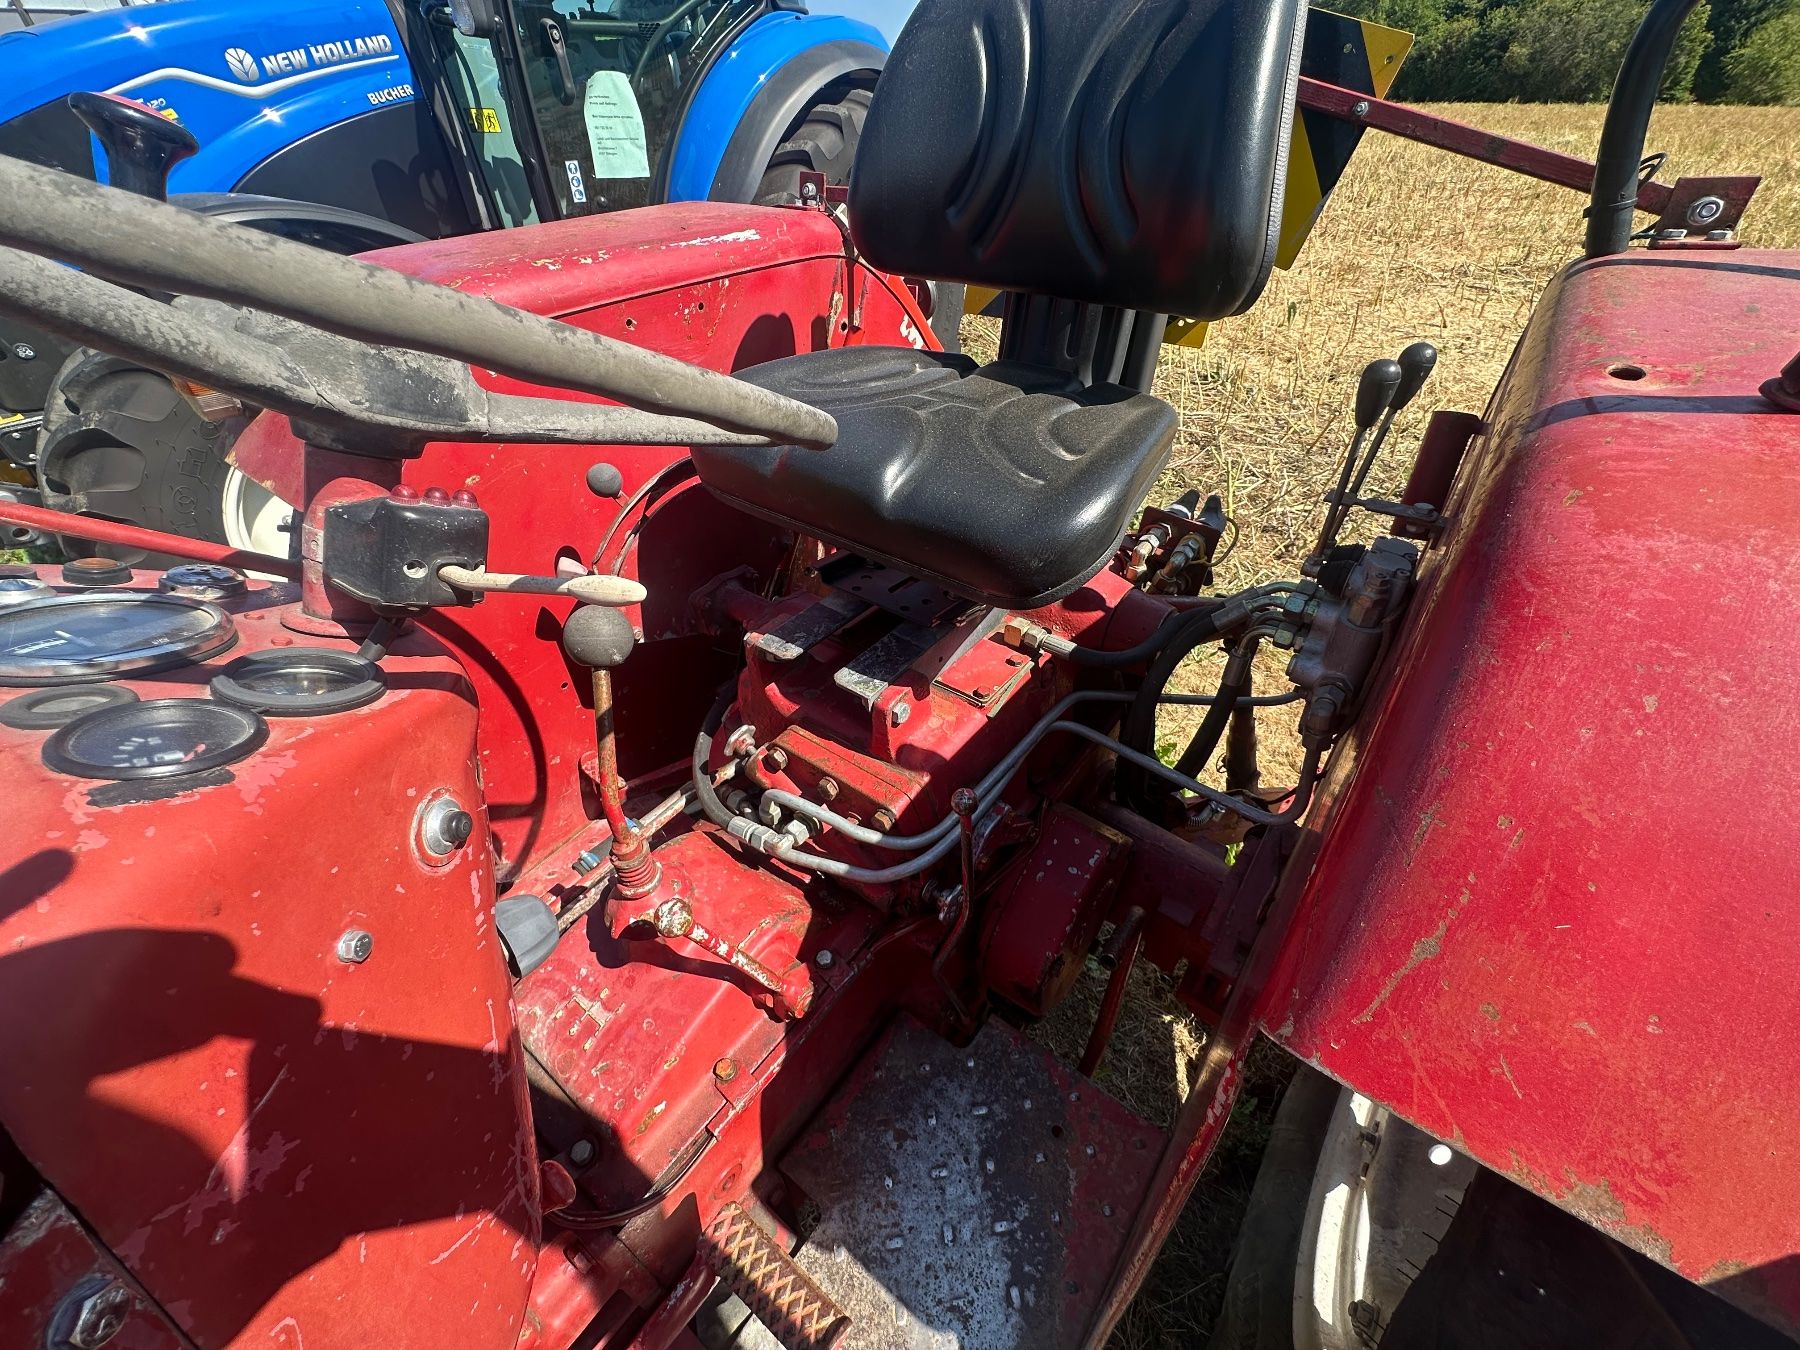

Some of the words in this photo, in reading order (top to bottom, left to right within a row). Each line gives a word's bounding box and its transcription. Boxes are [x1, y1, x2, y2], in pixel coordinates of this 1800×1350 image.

[261, 48, 309, 77] NEW
[309, 34, 393, 65] HOLLAND
[366, 84, 415, 105] BUCHER
